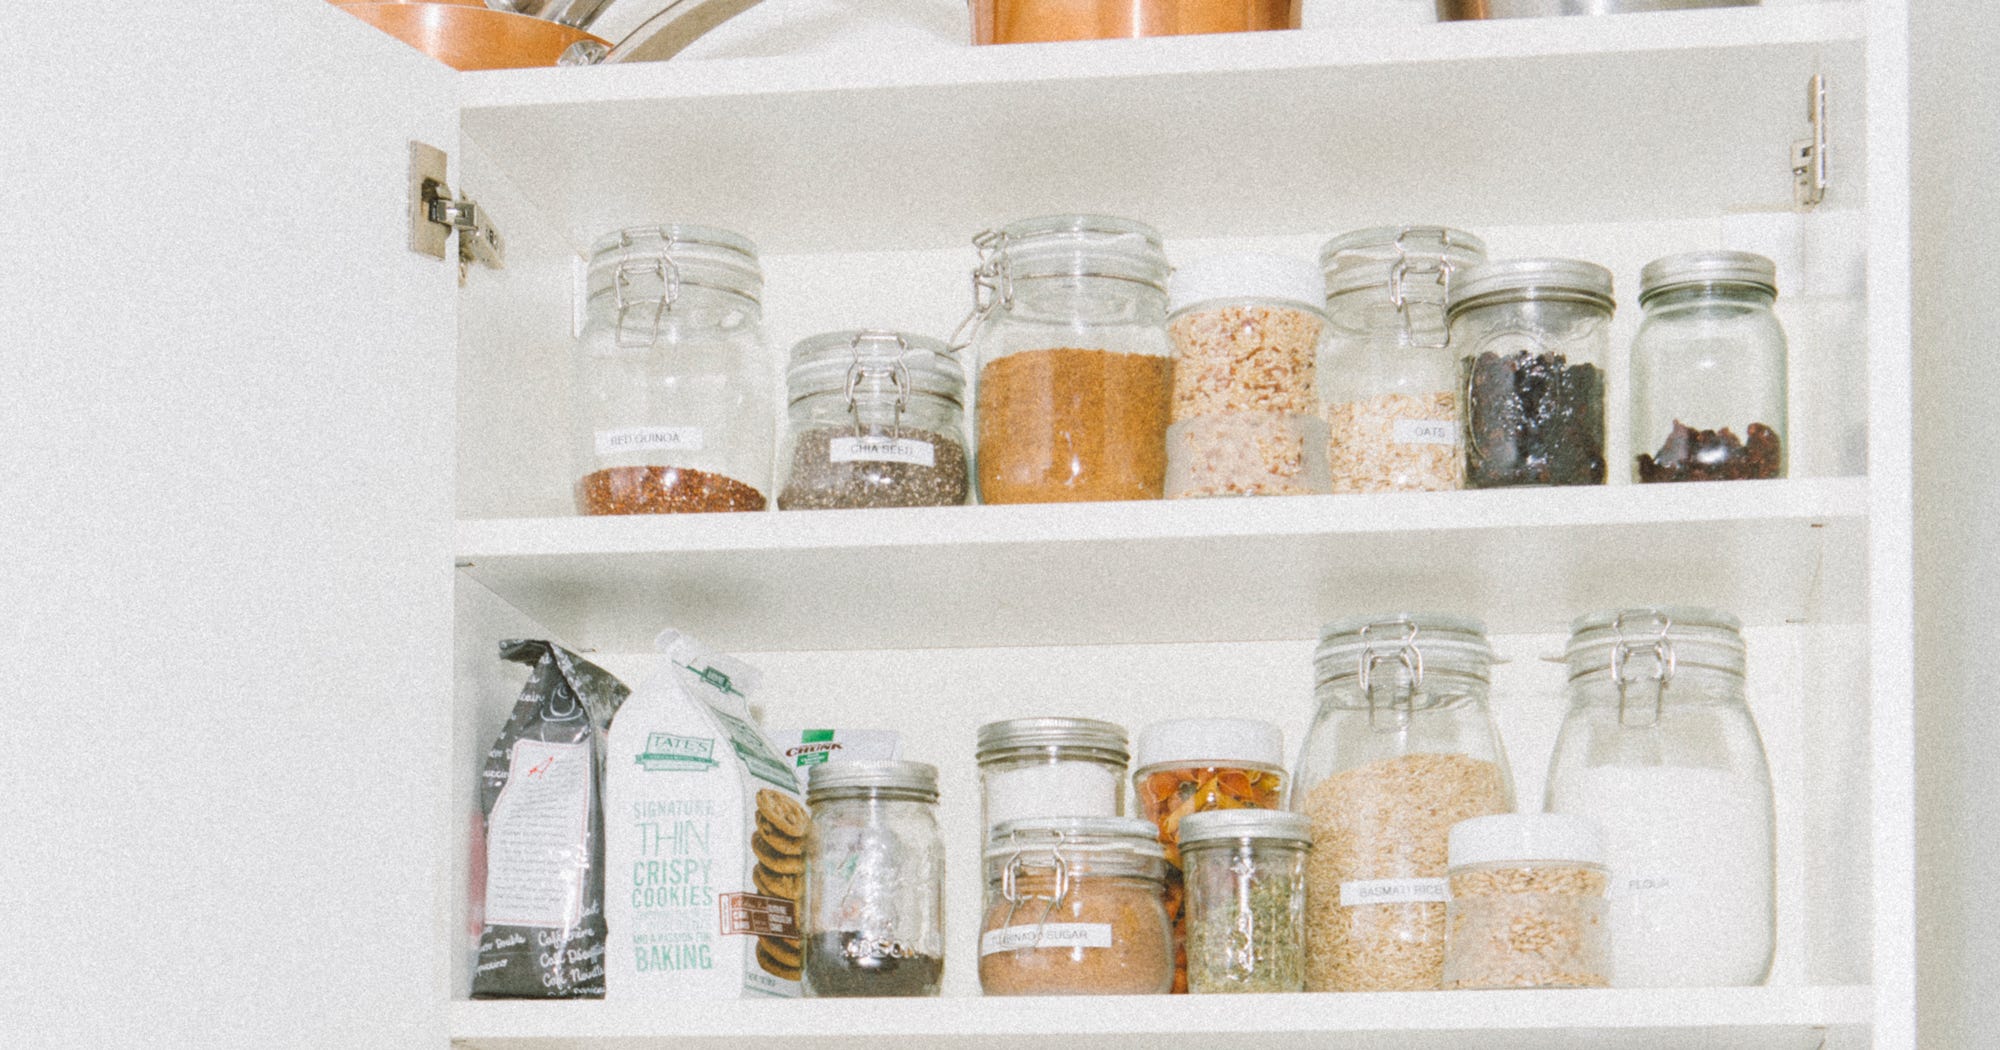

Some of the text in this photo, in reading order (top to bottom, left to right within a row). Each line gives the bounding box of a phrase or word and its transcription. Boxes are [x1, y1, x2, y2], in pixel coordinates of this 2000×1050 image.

[610, 432, 681, 446] RED QUINOA
[1414, 426, 1446, 438] OATS
[851, 444, 914, 456] CHIA SEED
[785, 743, 843, 757] CHUNK
[633, 799, 714, 819] SIGNATURE
[634, 820, 711, 856] THIN
[633, 858, 713, 887] CRISPY
[1359, 883, 1443, 898] BASMATI RICE
[1628, 878, 1671, 890] FLOUR
[631, 886, 714, 909] COOKIES
[1046, 930, 1087, 941] SUGAR
[634, 943, 713, 972] BAKING
